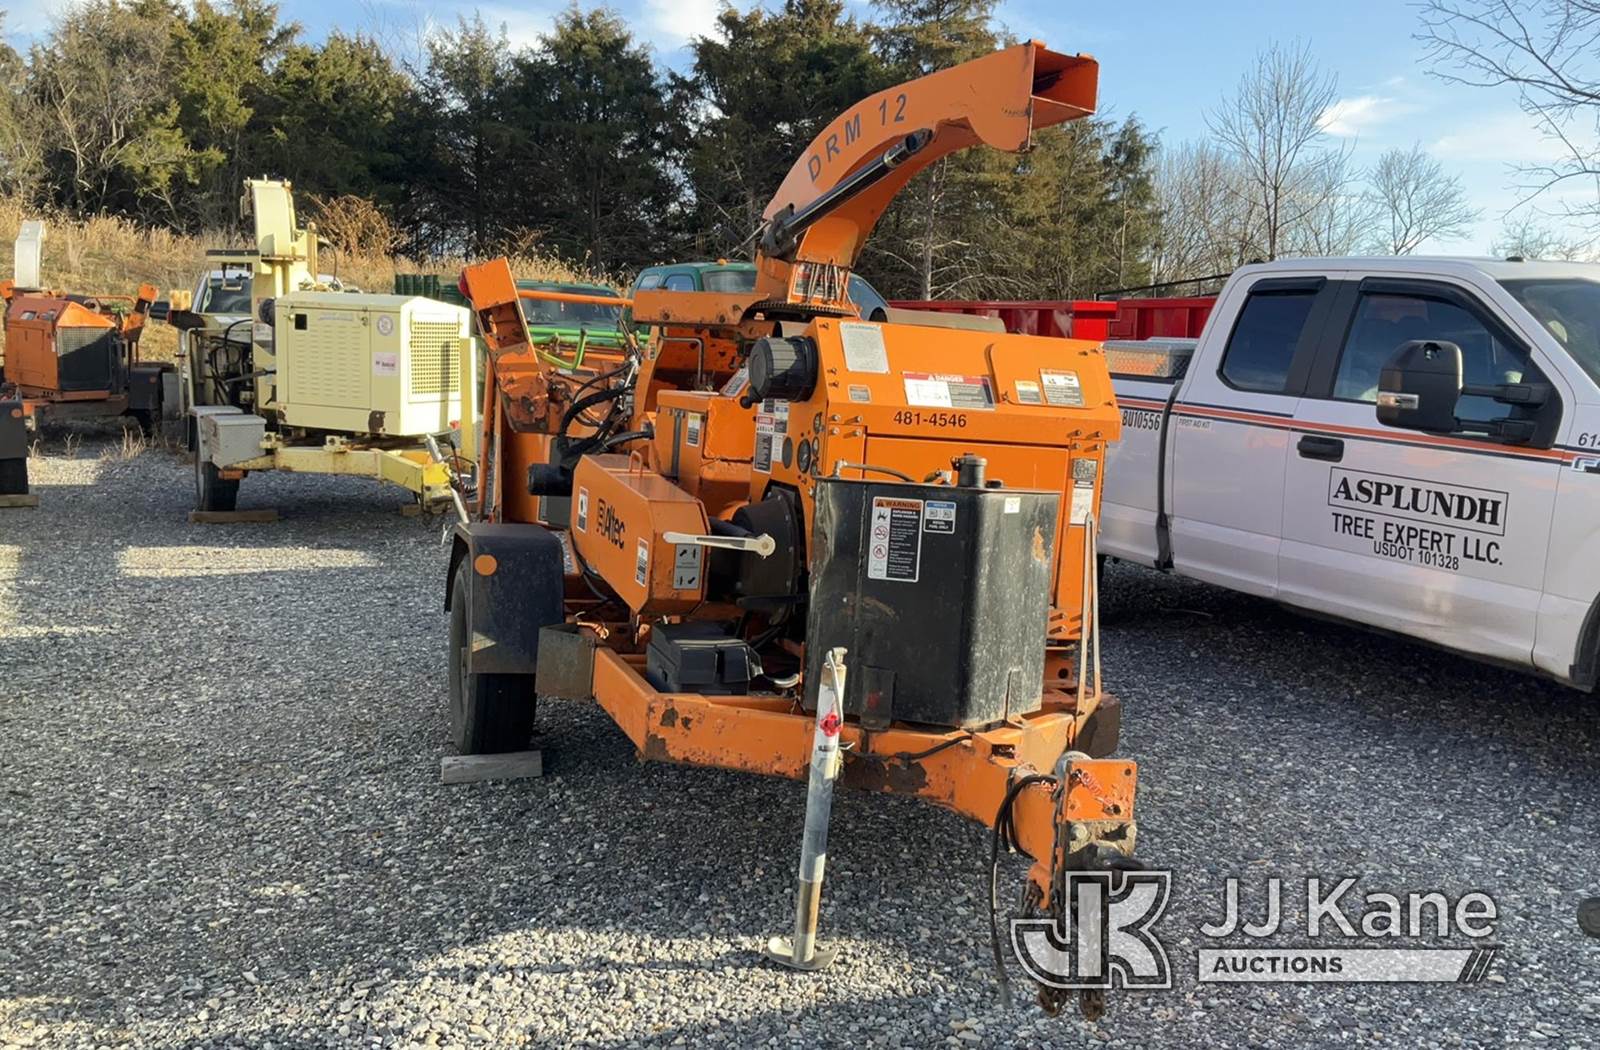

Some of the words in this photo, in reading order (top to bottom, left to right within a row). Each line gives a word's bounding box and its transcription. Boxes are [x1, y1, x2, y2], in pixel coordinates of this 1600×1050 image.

[807, 112, 861, 182] DRM
[878, 93, 908, 126] 12
[893, 410, 967, 428] 481-4546
[1578, 432, 1600, 447] 61
[885, 500, 921, 509] WARNING
[1333, 477, 1502, 526] ASPLUNDH
[1332, 512, 1375, 539] TREE
[1383, 522, 1456, 555] EXPERT
[1463, 536, 1503, 565] LLC.
[1373, 540, 1414, 561] USDOT
[1418, 551, 1459, 571] 101328
